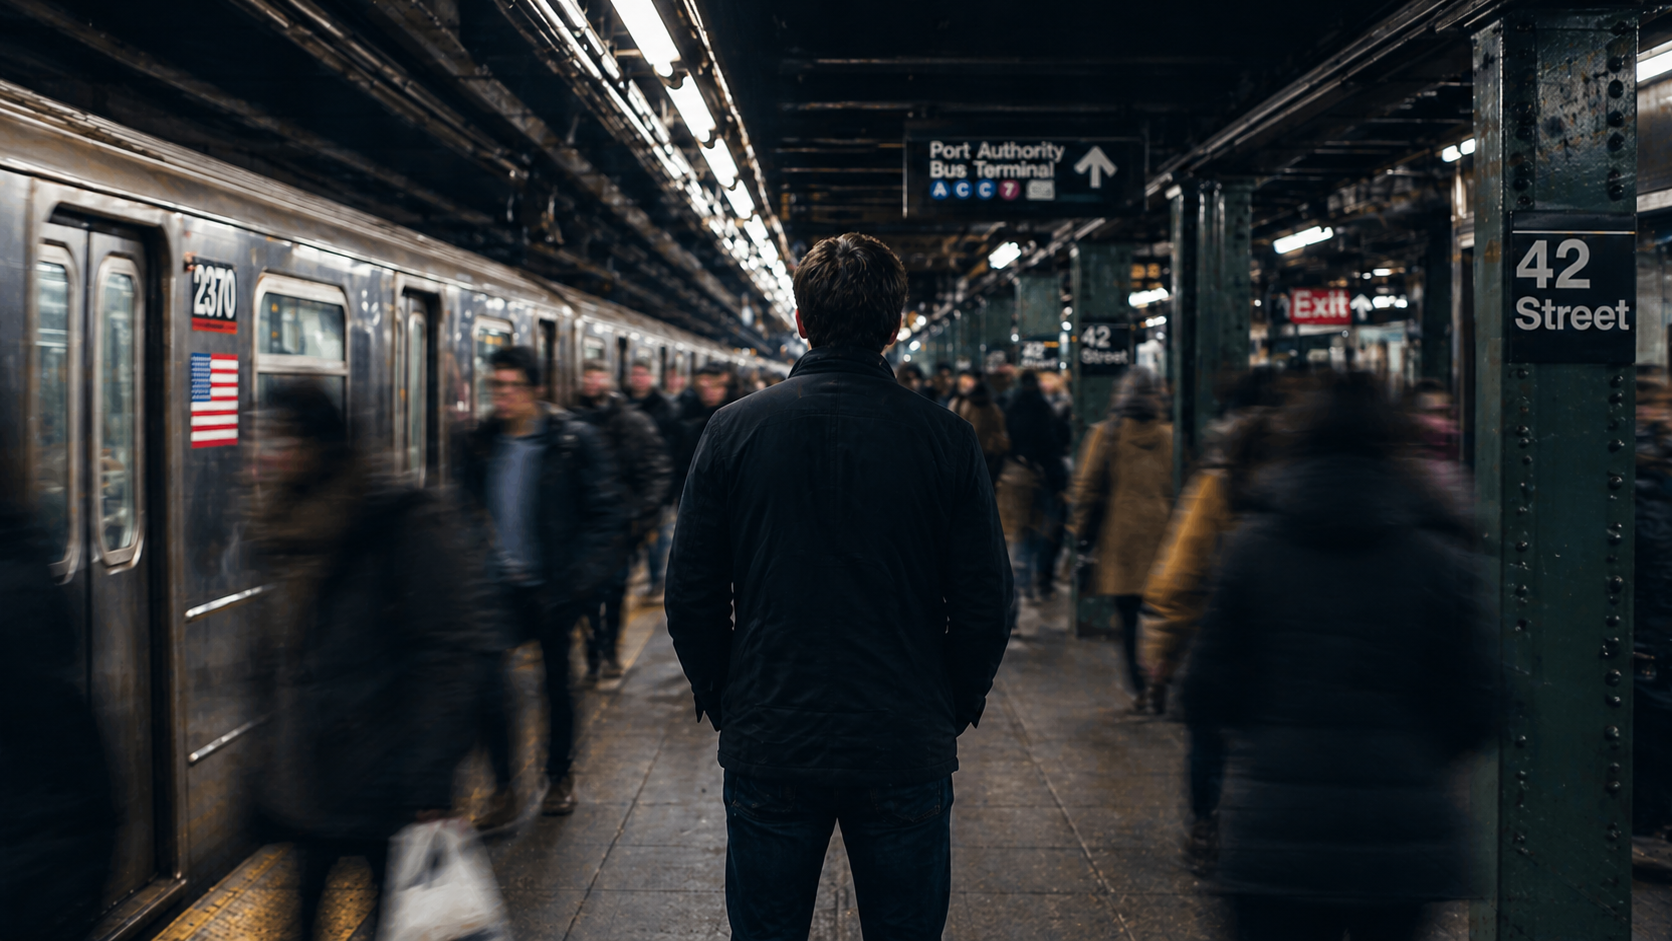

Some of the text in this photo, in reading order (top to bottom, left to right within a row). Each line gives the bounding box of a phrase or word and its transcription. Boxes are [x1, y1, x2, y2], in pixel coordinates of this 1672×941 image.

[929, 140, 1066, 163] Port Authority
[929, 160, 1055, 179] Bus Terminal
[932, 181, 949, 197] A
[955, 182, 970, 198] C
[1002, 181, 1015, 197] 7
[1516, 238, 1591, 289] 42
[193, 264, 237, 319] 2370
[1293, 290, 1349, 319] Exit
[1515, 296, 1630, 331] Street
[1081, 325, 1111, 348] 42
[1080, 350, 1129, 364] Street
